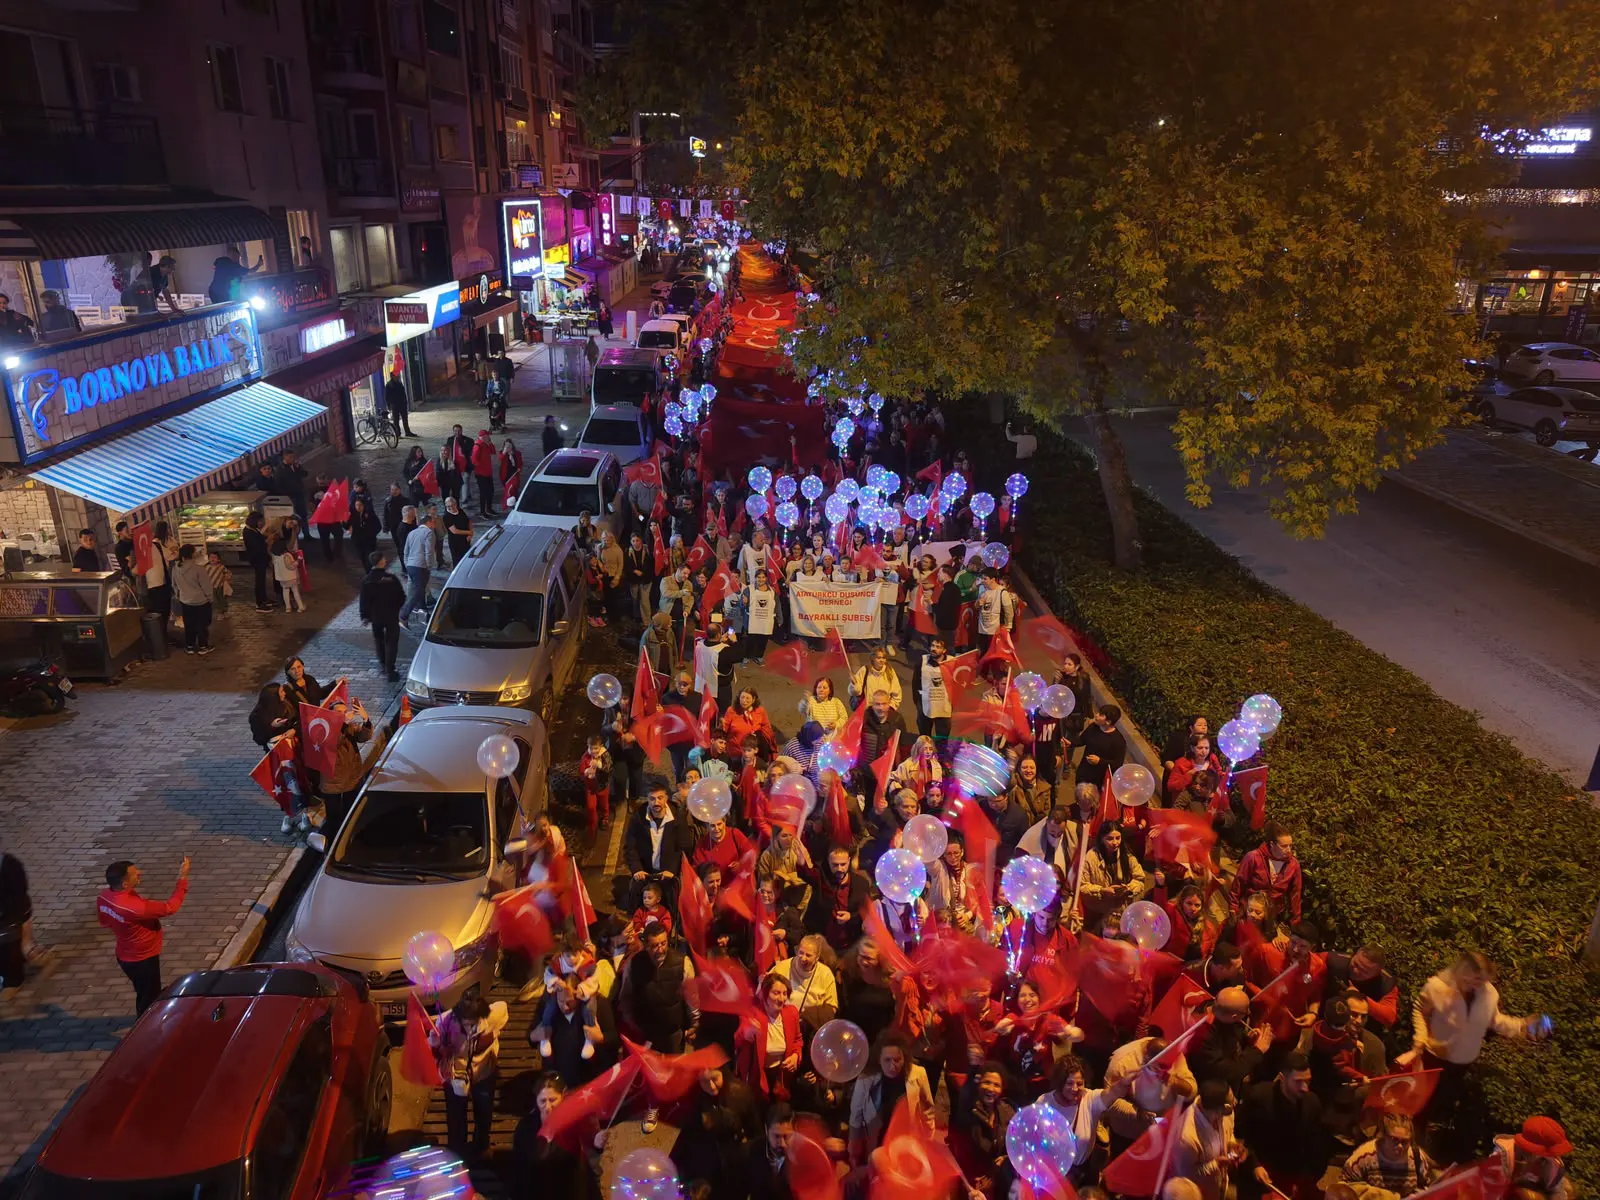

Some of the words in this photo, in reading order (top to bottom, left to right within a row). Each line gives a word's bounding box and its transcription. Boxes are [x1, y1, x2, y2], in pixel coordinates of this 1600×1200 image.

[388, 304, 425, 314] AVANTAJ
[399, 314, 416, 322] AVM
[61, 350, 175, 415] BORNOVA
[174, 333, 234, 379] BALIK
[798, 613, 839, 622] BAYRAKLI
